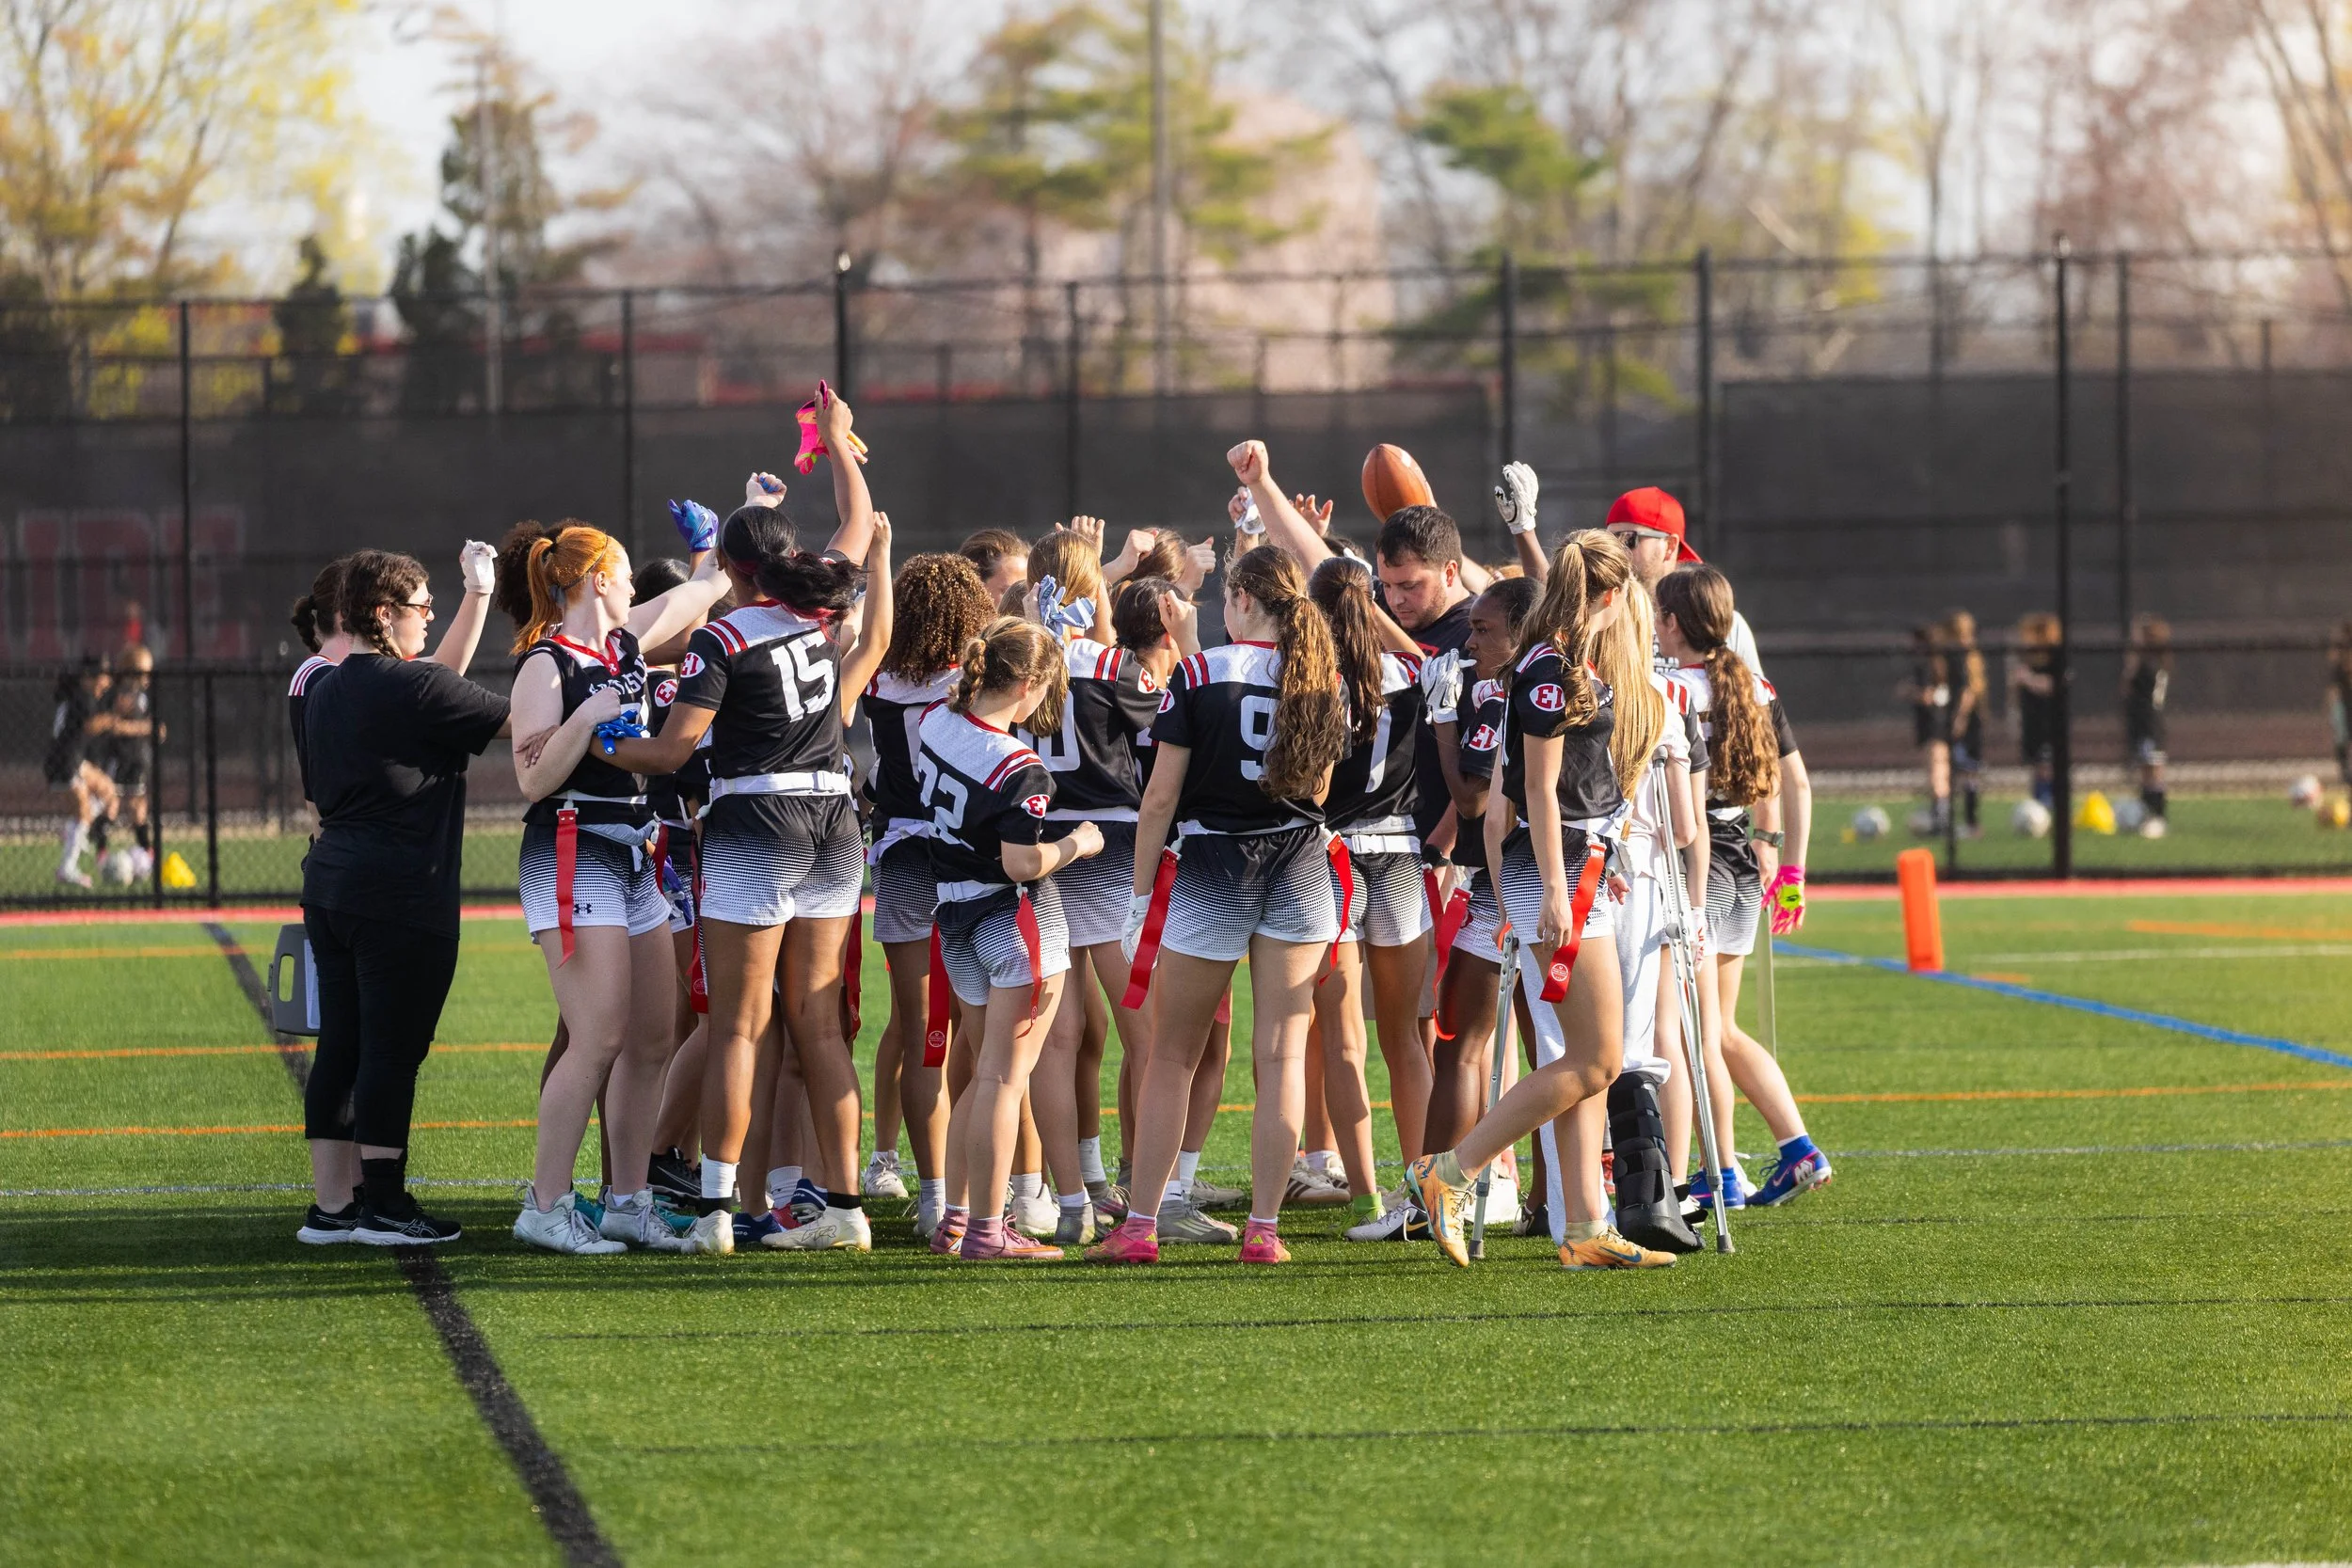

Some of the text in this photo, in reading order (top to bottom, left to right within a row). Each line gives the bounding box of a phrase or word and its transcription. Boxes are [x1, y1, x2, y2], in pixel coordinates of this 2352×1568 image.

[771, 630, 835, 722] 15
[1535, 685, 1563, 708] EI
[1470, 725, 1496, 749] EI
